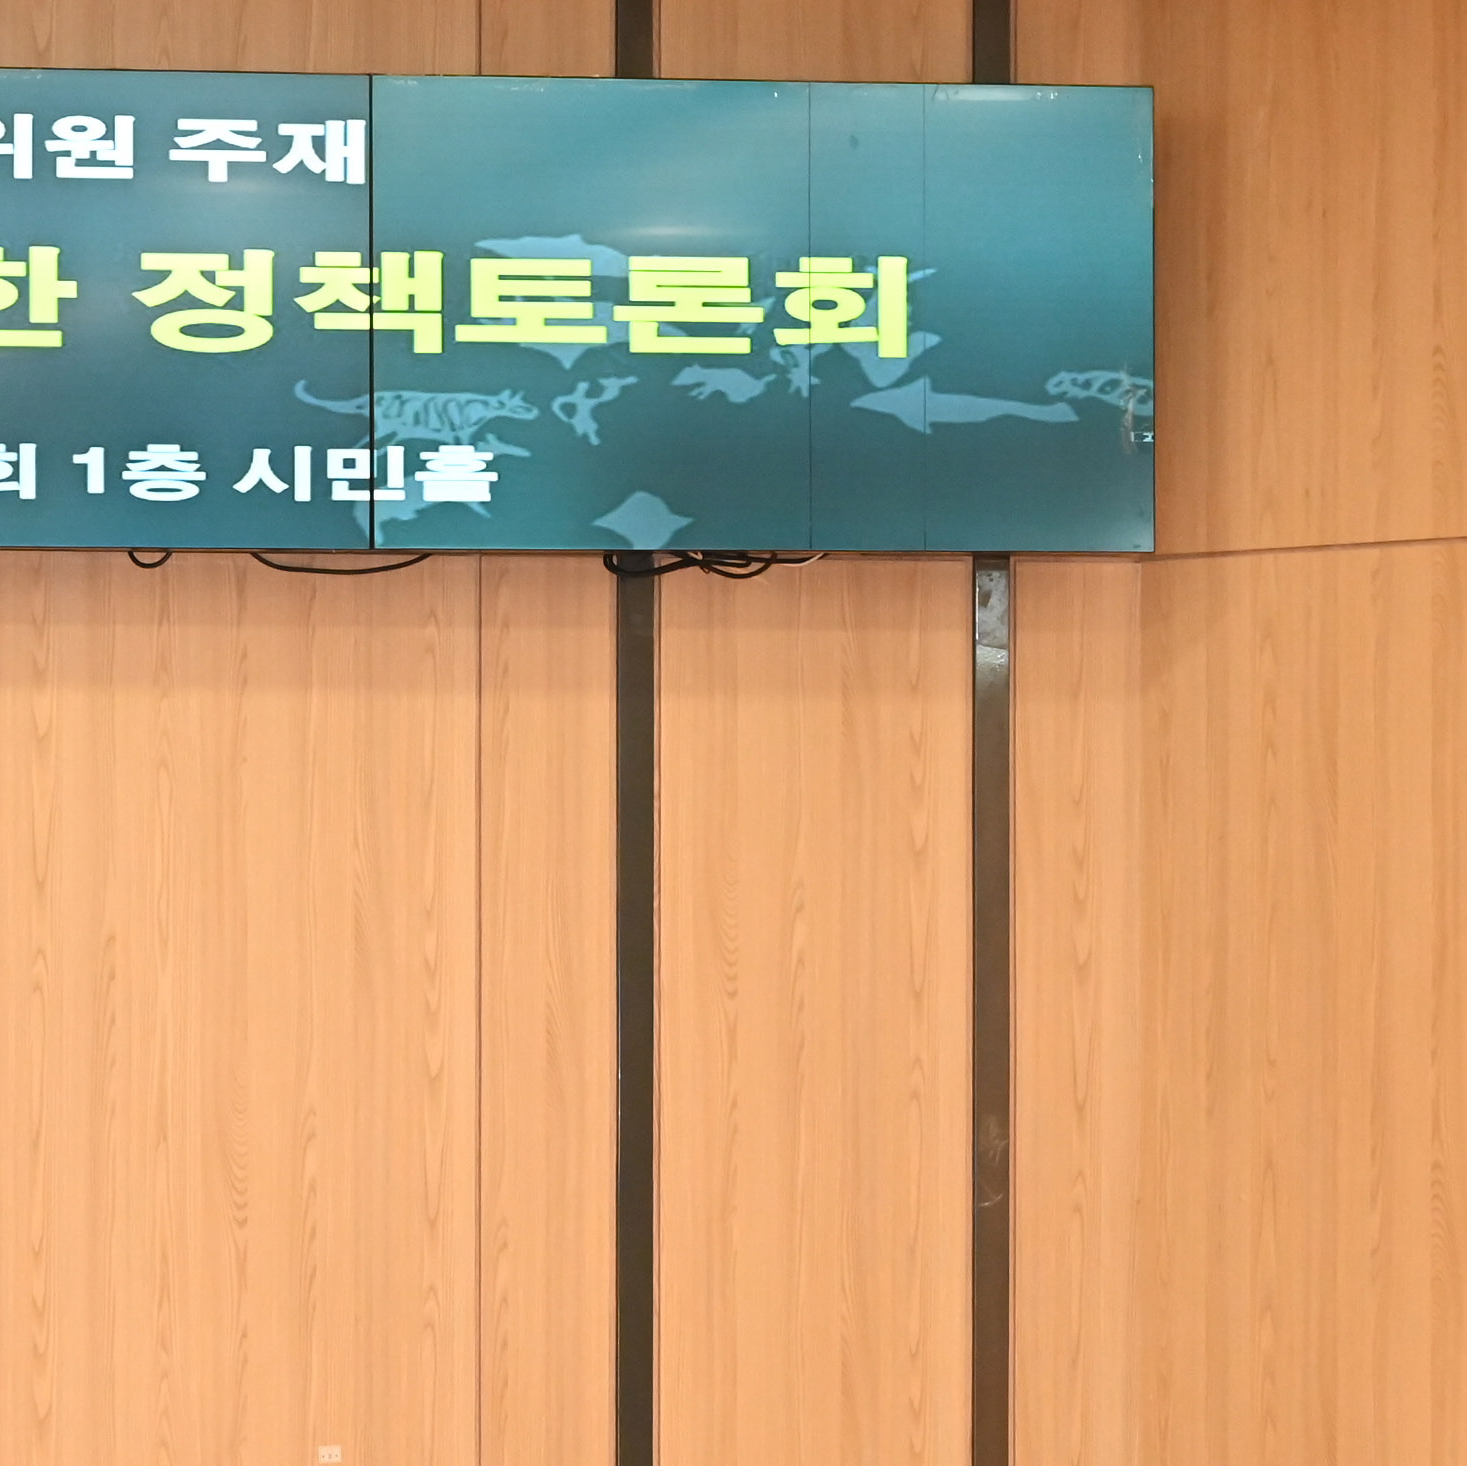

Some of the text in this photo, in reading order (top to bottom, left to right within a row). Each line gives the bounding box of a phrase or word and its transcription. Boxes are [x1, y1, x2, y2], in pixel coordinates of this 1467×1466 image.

[169, 118, 367, 184] 주재
[132, 248, 909, 358] 정책토론회
[73, 444, 207, 501] 1층
[233, 445, 498, 502] 시민홀
